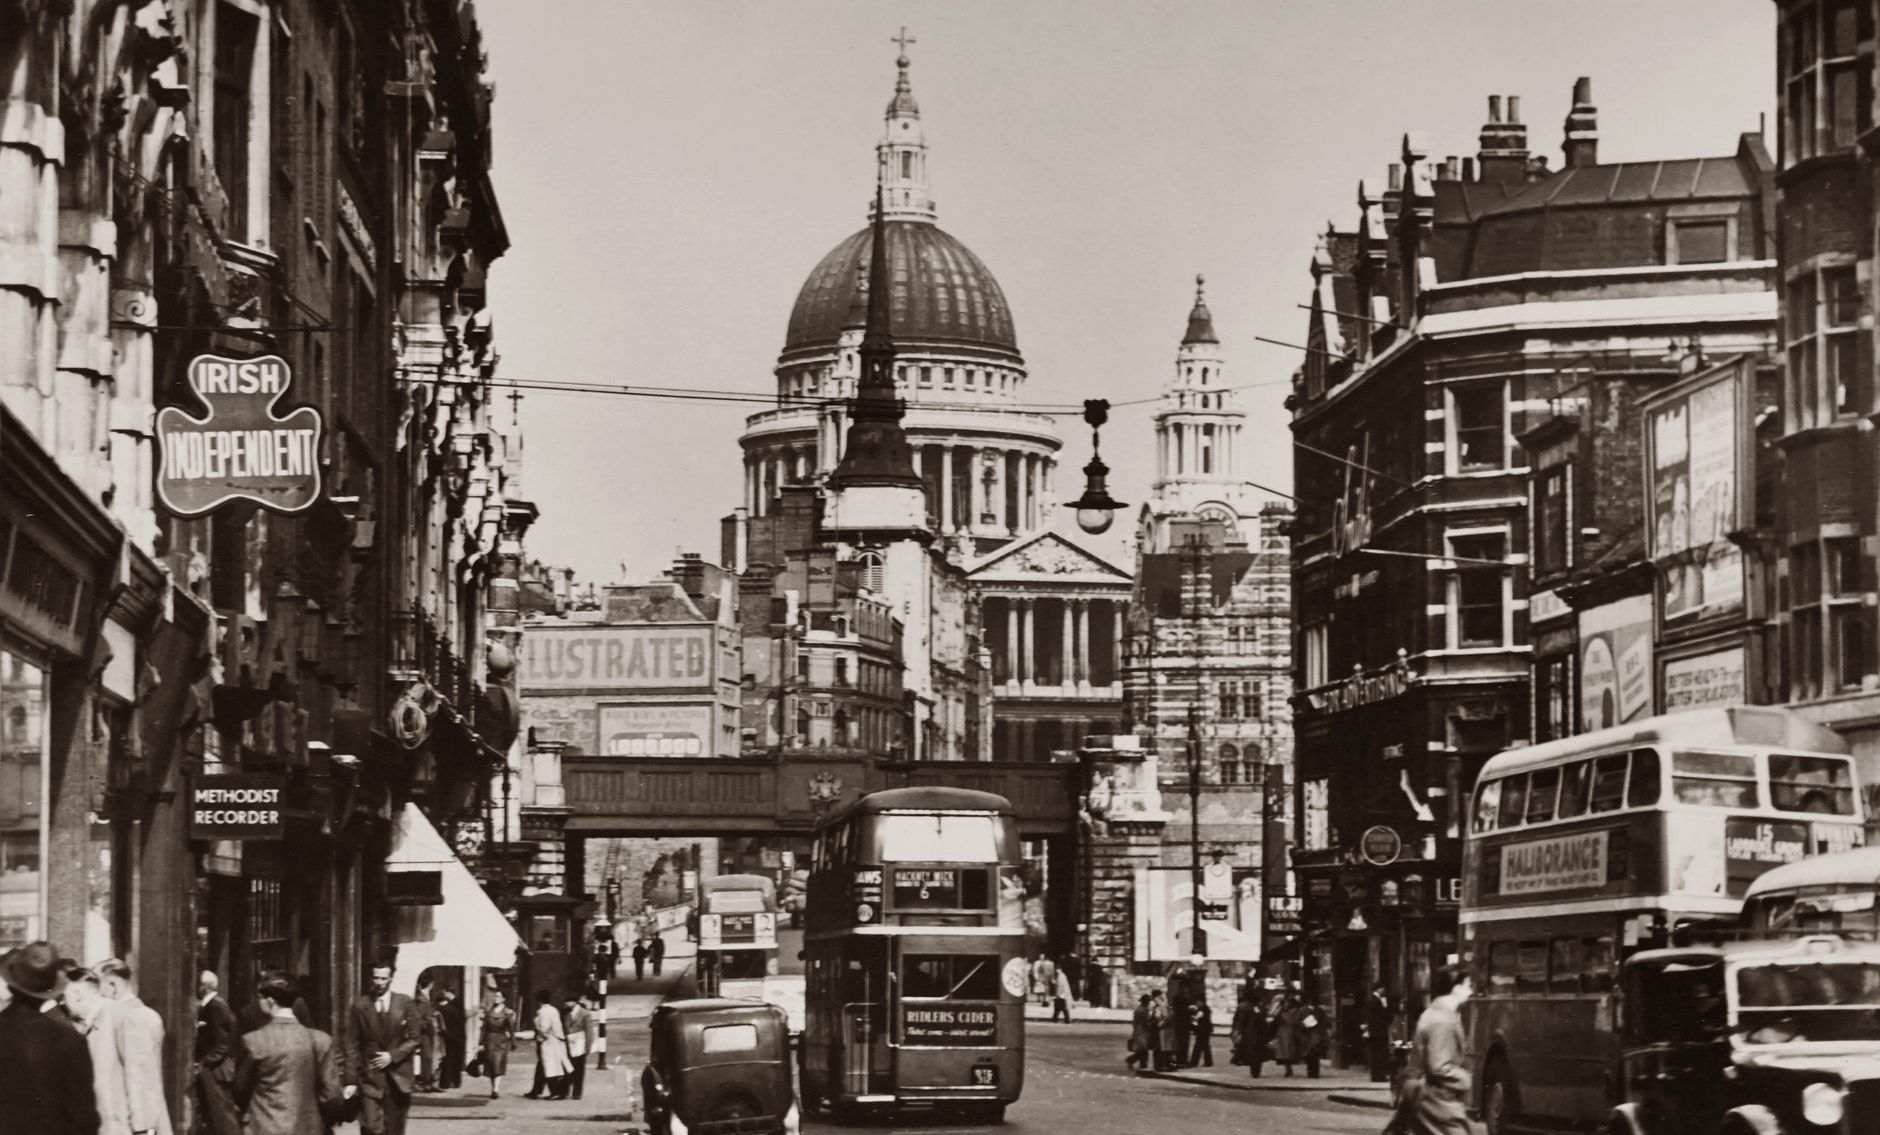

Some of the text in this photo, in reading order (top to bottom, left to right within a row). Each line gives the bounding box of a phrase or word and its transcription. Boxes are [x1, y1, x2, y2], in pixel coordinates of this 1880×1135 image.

[198, 363, 280, 394] IRISH
[166, 429, 314, 479] INDEPENDENT
[520, 637, 706, 680] LUSTRATED
[194, 789, 279, 803] METHODIST
[194, 810, 279, 824] RECORDER
[1756, 823, 1774, 839] 15
[1506, 837, 1601, 878] HALIBORANGE
[933, 871, 954, 881] WICK
[919, 886, 930, 900] 6
[907, 1011, 994, 1024] RIDLERS CIDER
